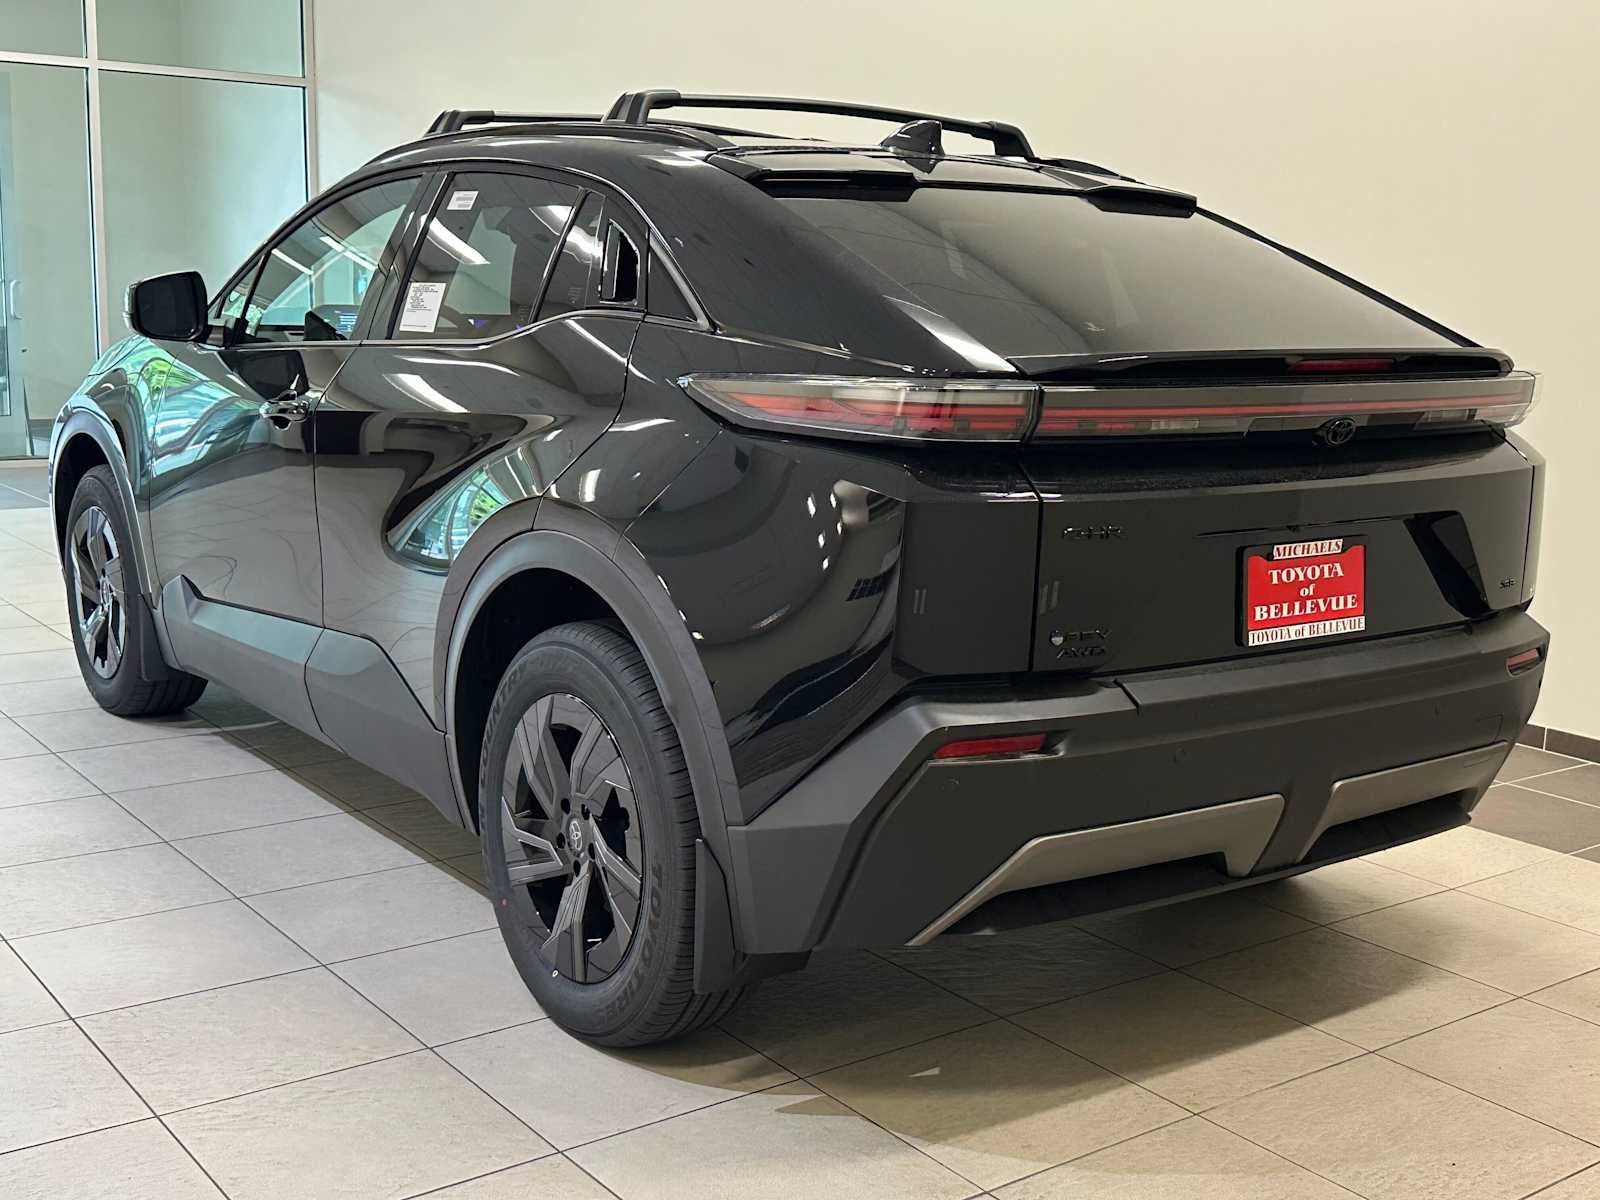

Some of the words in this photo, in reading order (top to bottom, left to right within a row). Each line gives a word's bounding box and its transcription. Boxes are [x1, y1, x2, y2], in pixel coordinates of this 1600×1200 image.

[1274, 540, 1343, 559] MICHAELS
[1268, 562, 1344, 584] TOYOTA
[1300, 584, 1315, 597] of
[1254, 594, 1358, 621] BELLEVUE
[1250, 630, 1292, 645] TOYOTA
[1294, 626, 1306, 638] of
[1308, 617, 1364, 636] BELLEVUE
